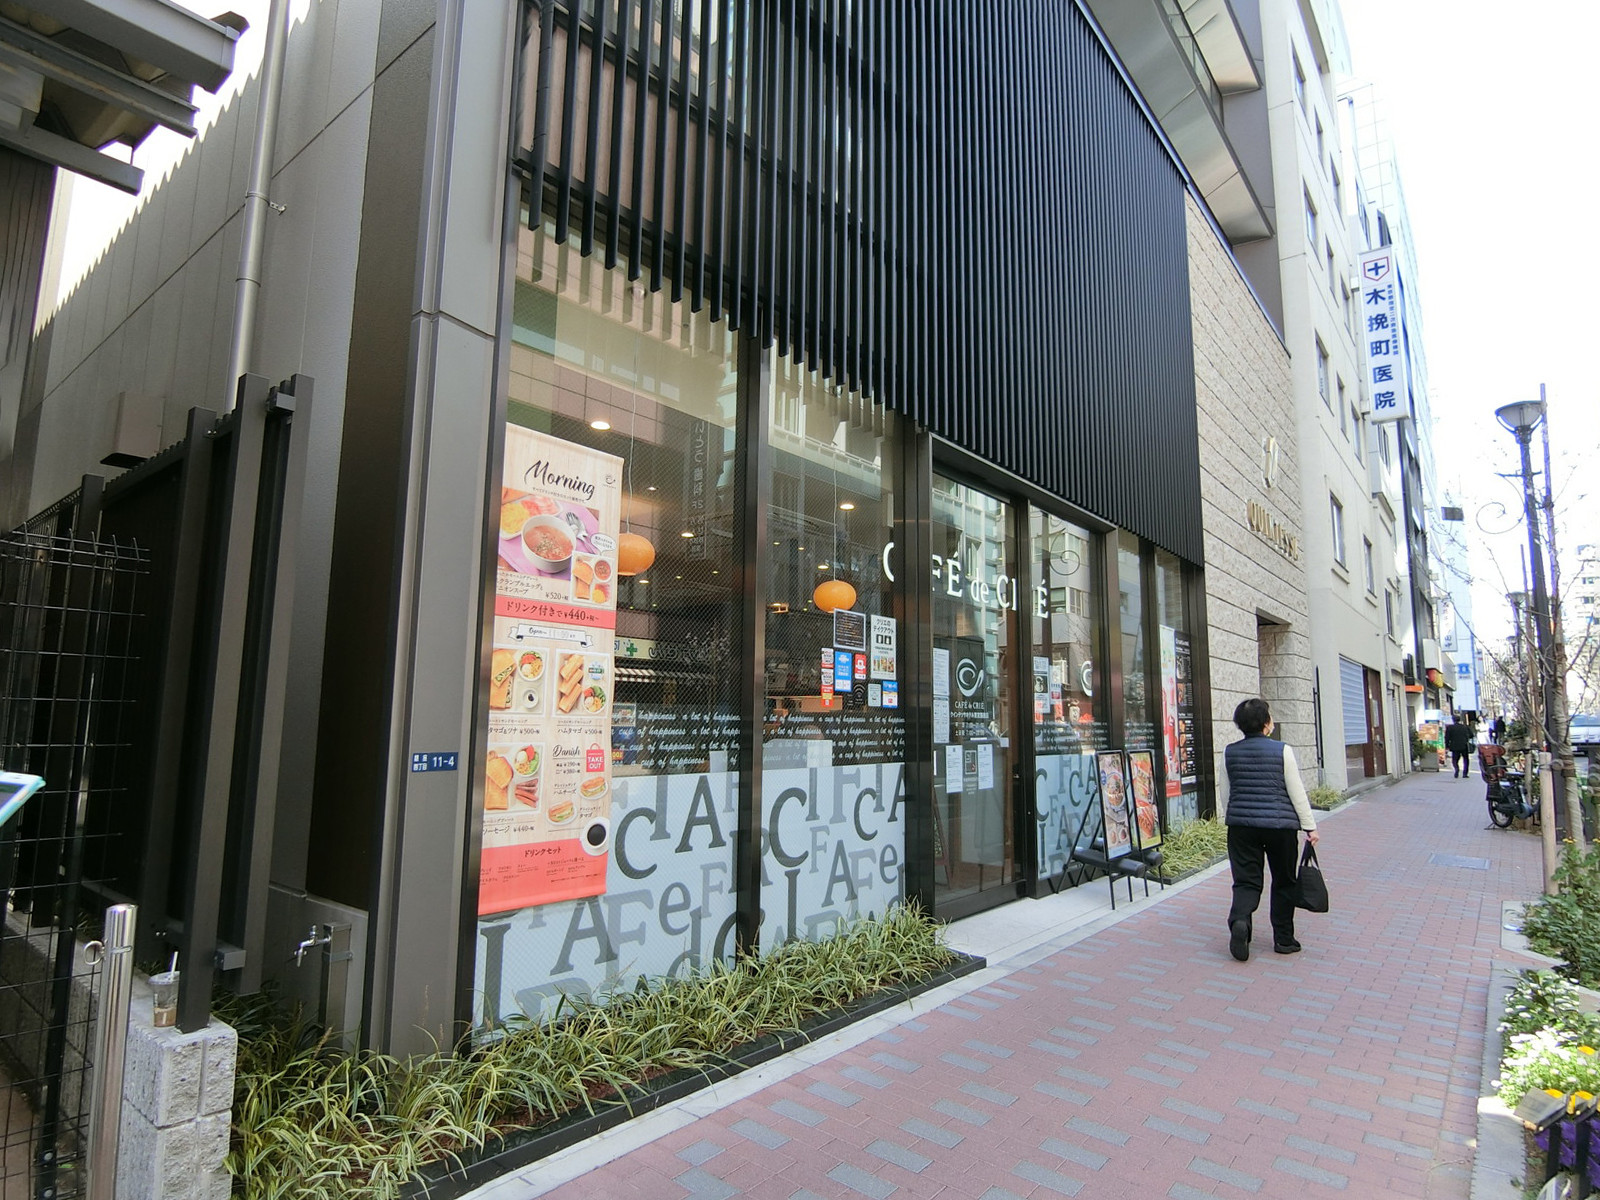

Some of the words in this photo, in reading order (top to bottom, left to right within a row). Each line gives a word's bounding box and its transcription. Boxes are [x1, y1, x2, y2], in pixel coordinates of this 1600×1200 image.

[1365, 288, 1396, 410] 木挽町医院
[524, 460, 595, 501] Morning
[497, 578, 543, 591] クランブルエッグと
[970, 568, 990, 604] de
[497, 586, 528, 597] ニオンスープ
[552, 744, 580, 758] Danish
[432, 756, 455, 768] 11-4
[589, 762, 602, 770] OUT
[524, 847, 562, 858] ドリンクセット
